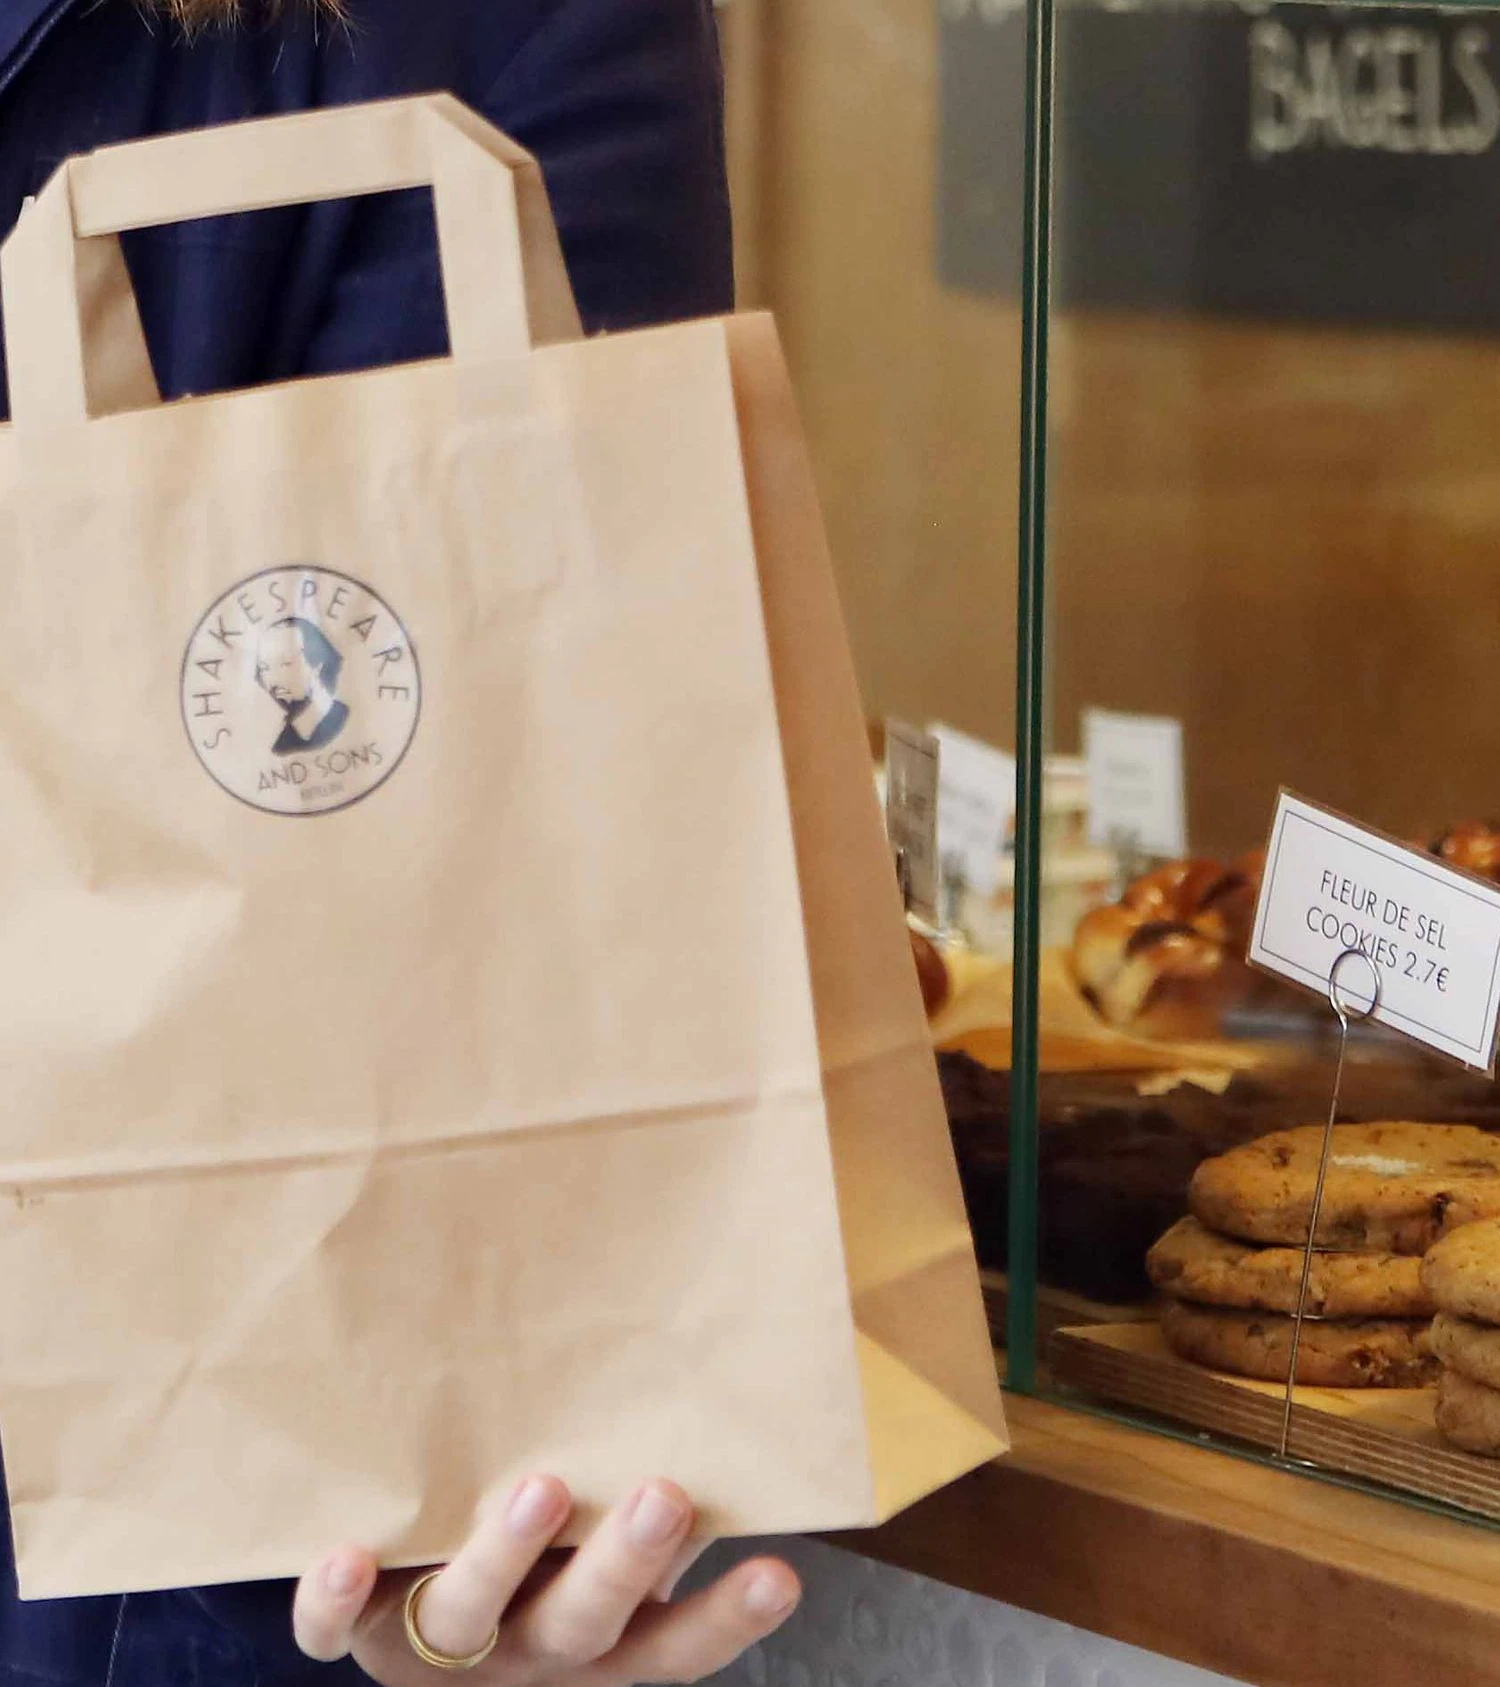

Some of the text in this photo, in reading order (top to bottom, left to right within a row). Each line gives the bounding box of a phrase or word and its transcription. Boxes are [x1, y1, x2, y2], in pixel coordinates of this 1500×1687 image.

[191, 579, 410, 750] SHAKESPEARE
[258, 742, 383, 791] AND SONS
[1306, 906, 1450, 993] COOKIES 2.7€
[1320, 870, 1448, 951] FLEUR DE SEL
